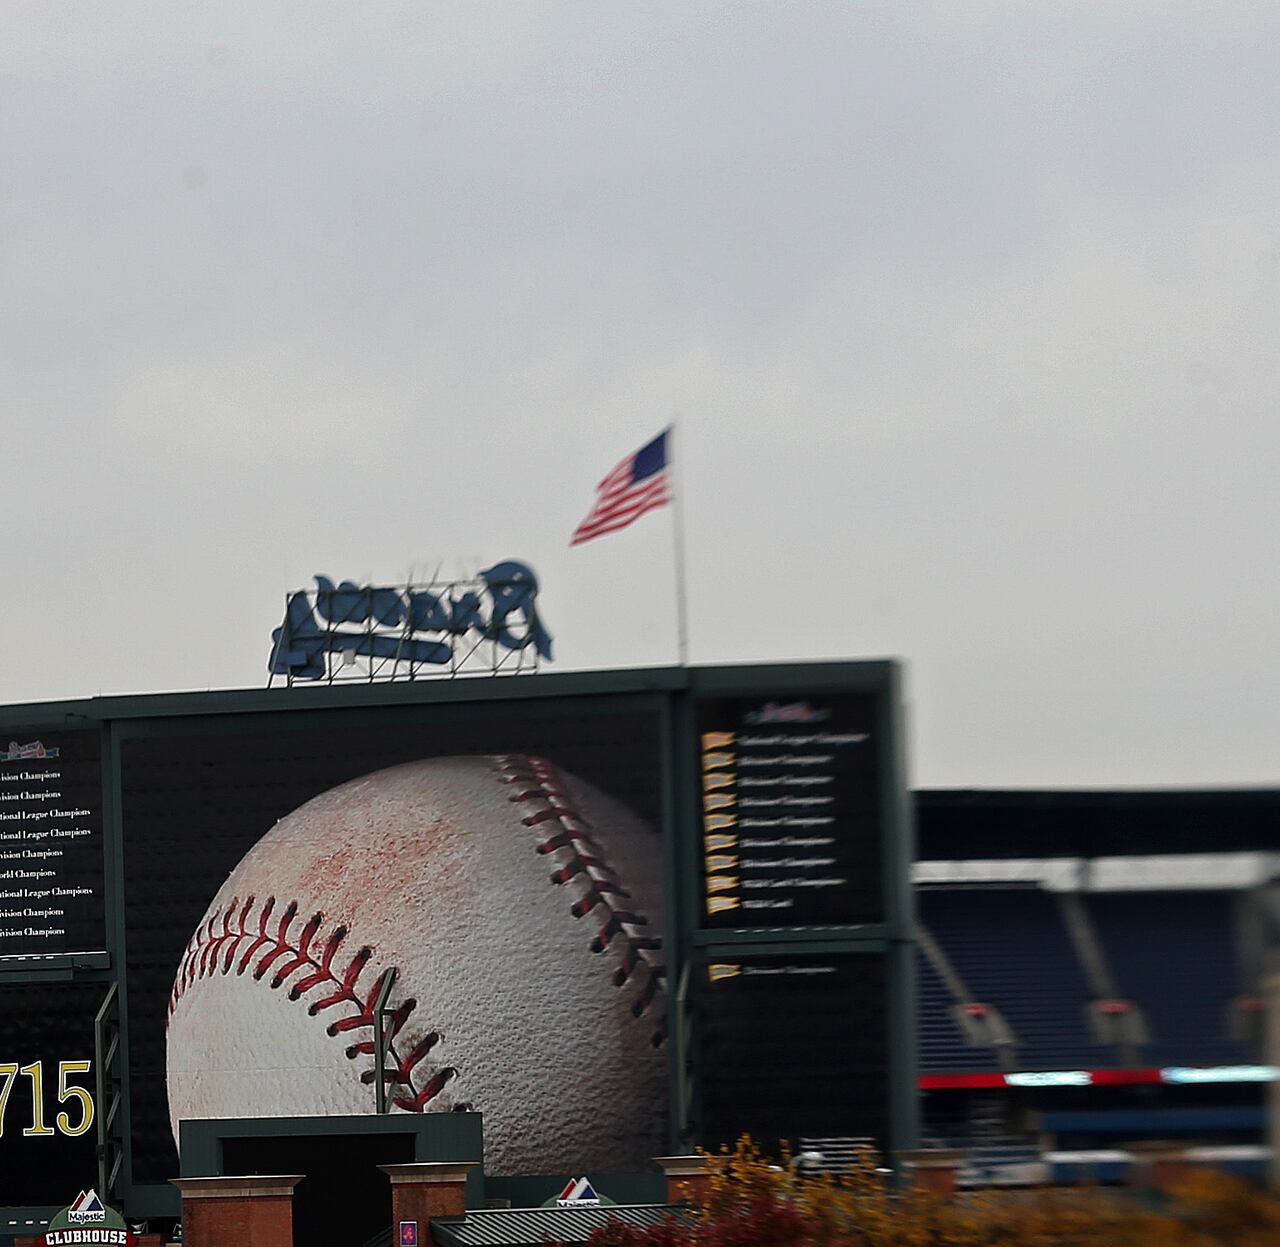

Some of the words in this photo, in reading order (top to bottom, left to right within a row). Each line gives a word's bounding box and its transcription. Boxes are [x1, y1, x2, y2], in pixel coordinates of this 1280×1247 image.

[20, 770, 61, 782] Champions
[20, 790, 62, 802] Champions
[22, 810, 48, 822] League
[50, 808, 91, 820] Champions
[23, 830, 49, 841] League
[50, 827, 92, 839] Champions
[22, 848, 64, 860] Champions
[15, 868, 56, 880] Champions
[24, 888, 50, 900] League
[52, 886, 93, 898] Champions
[23, 907, 64, 918] Champions
[24, 926, 65, 938] Champions
[69, 1212, 105, 1224] Majestic
[45, 1230, 128, 1246] CLUBHOUSE
